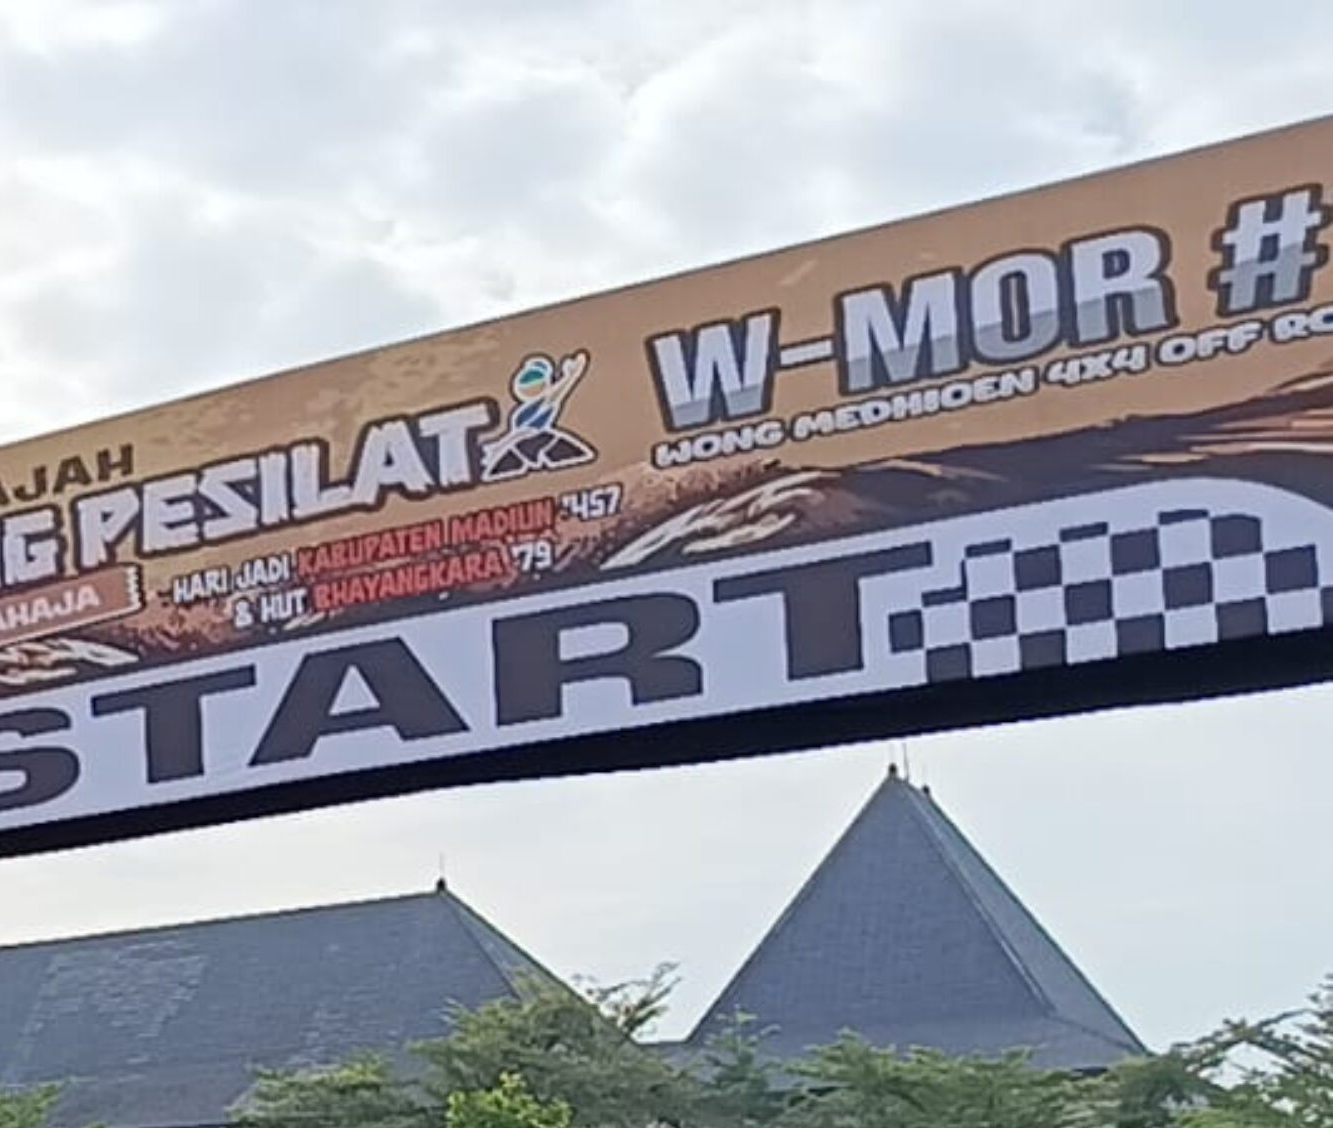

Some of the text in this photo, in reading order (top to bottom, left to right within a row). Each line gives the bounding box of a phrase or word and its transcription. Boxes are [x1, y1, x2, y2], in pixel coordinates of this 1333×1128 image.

[651, 229, 1171, 430] W-MOR
[654, 424, 783, 467] WONG
[1158, 321, 1262, 364] OFF
[76, 406, 493, 568] PESILAT
[172, 568, 230, 605] HARI
[234, 554, 292, 591] JADI
[298, 521, 444, 576] KABUPATEN
[450, 498, 555, 544] MADIUN
[260, 588, 307, 622] HUT
[313, 550, 504, 613] BHAYANGKARA
